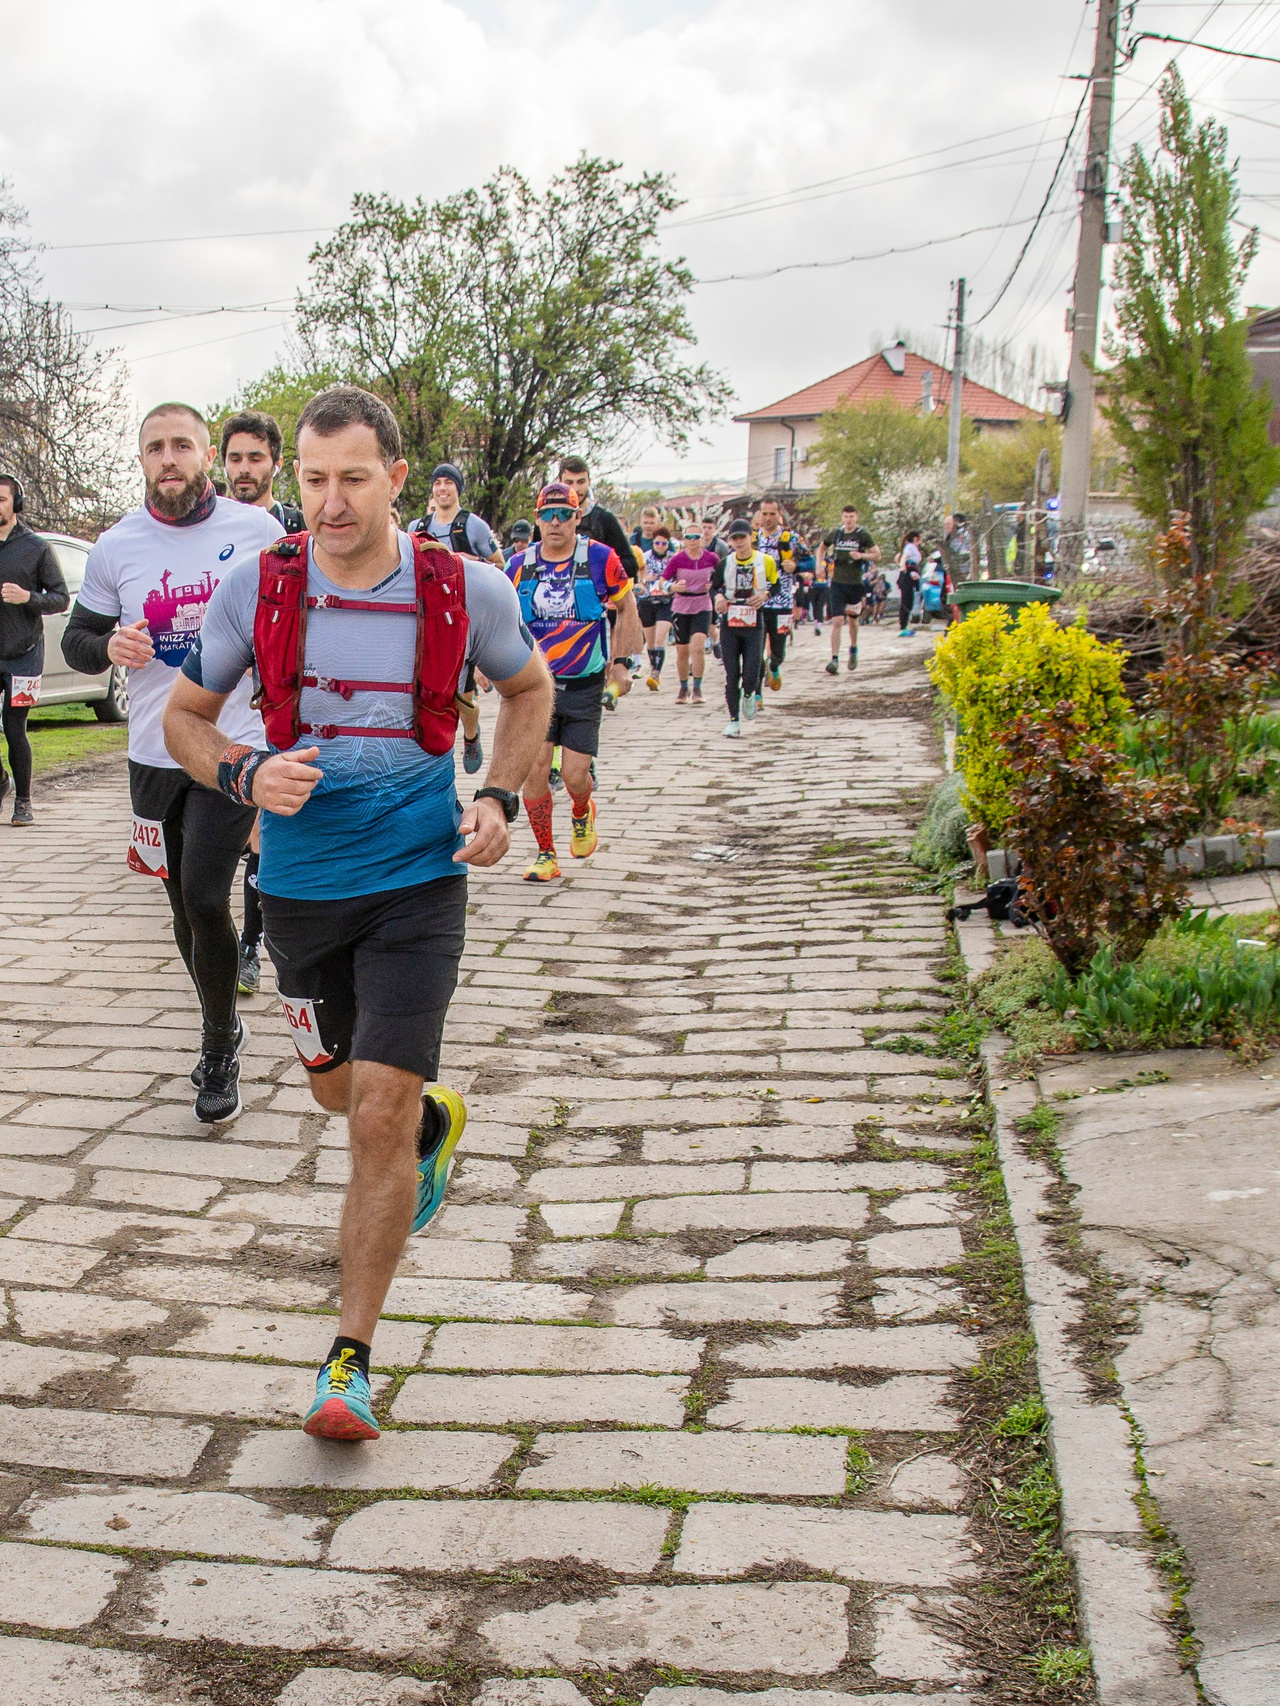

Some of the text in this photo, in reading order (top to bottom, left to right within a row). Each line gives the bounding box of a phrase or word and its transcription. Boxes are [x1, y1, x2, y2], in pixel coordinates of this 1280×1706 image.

[160, 630, 200, 642] WIZZ AI
[132, 820, 162, 847] 2412
